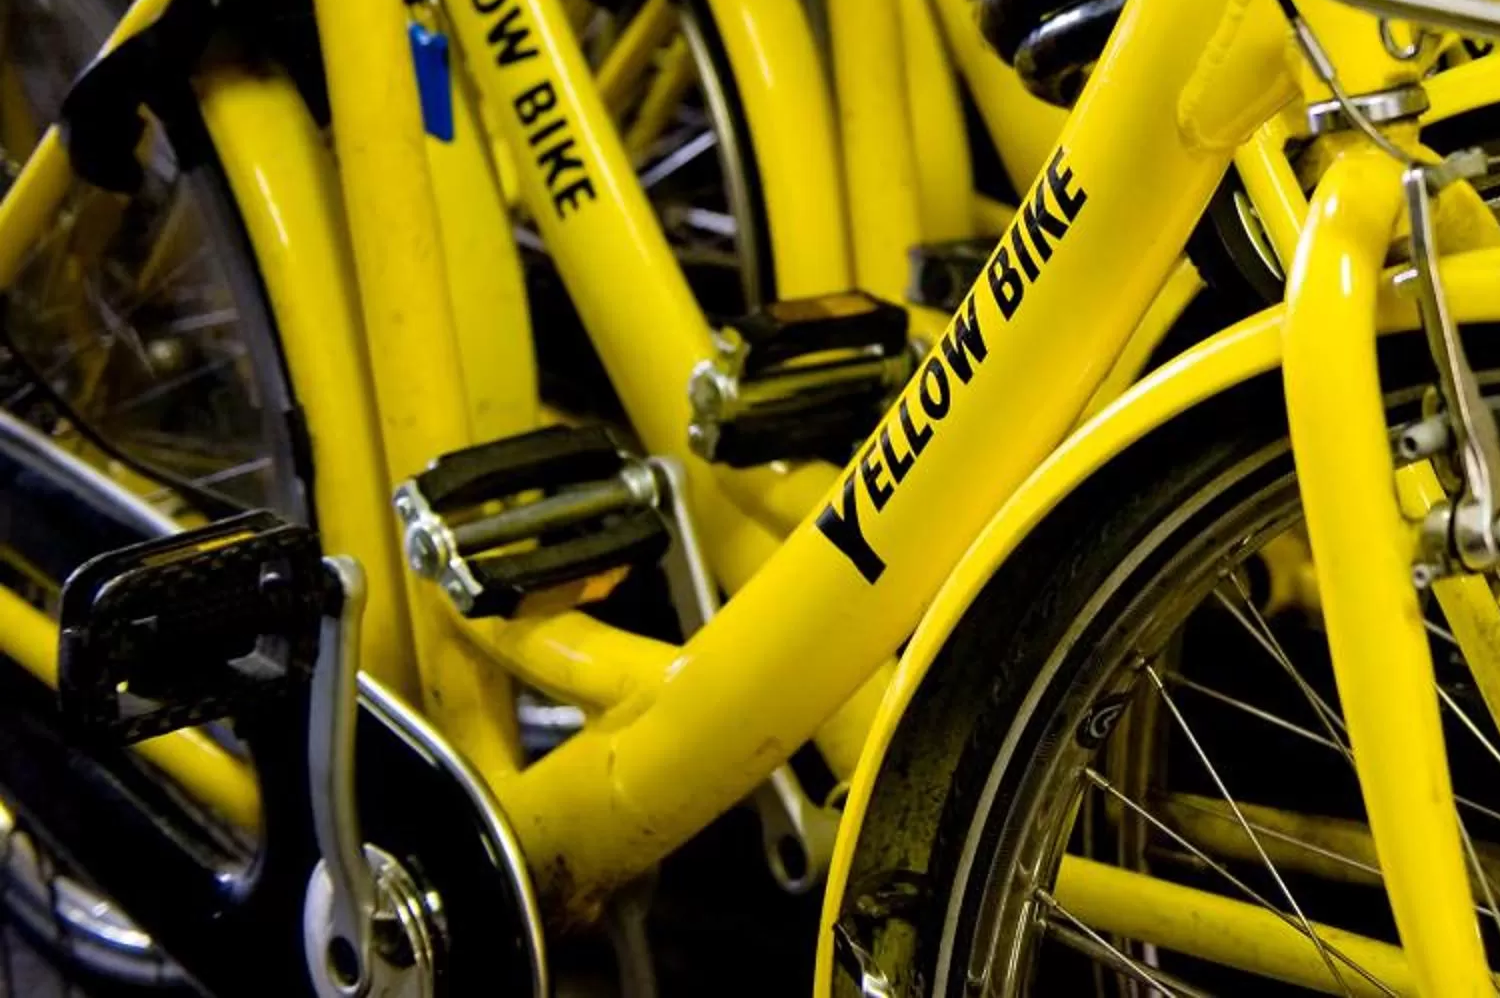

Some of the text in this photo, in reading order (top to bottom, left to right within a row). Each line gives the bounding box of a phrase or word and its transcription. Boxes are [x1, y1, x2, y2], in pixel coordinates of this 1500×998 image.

[513, 81, 597, 221] BIKE
[815, 145, 1088, 585] YELLOW BIKE
